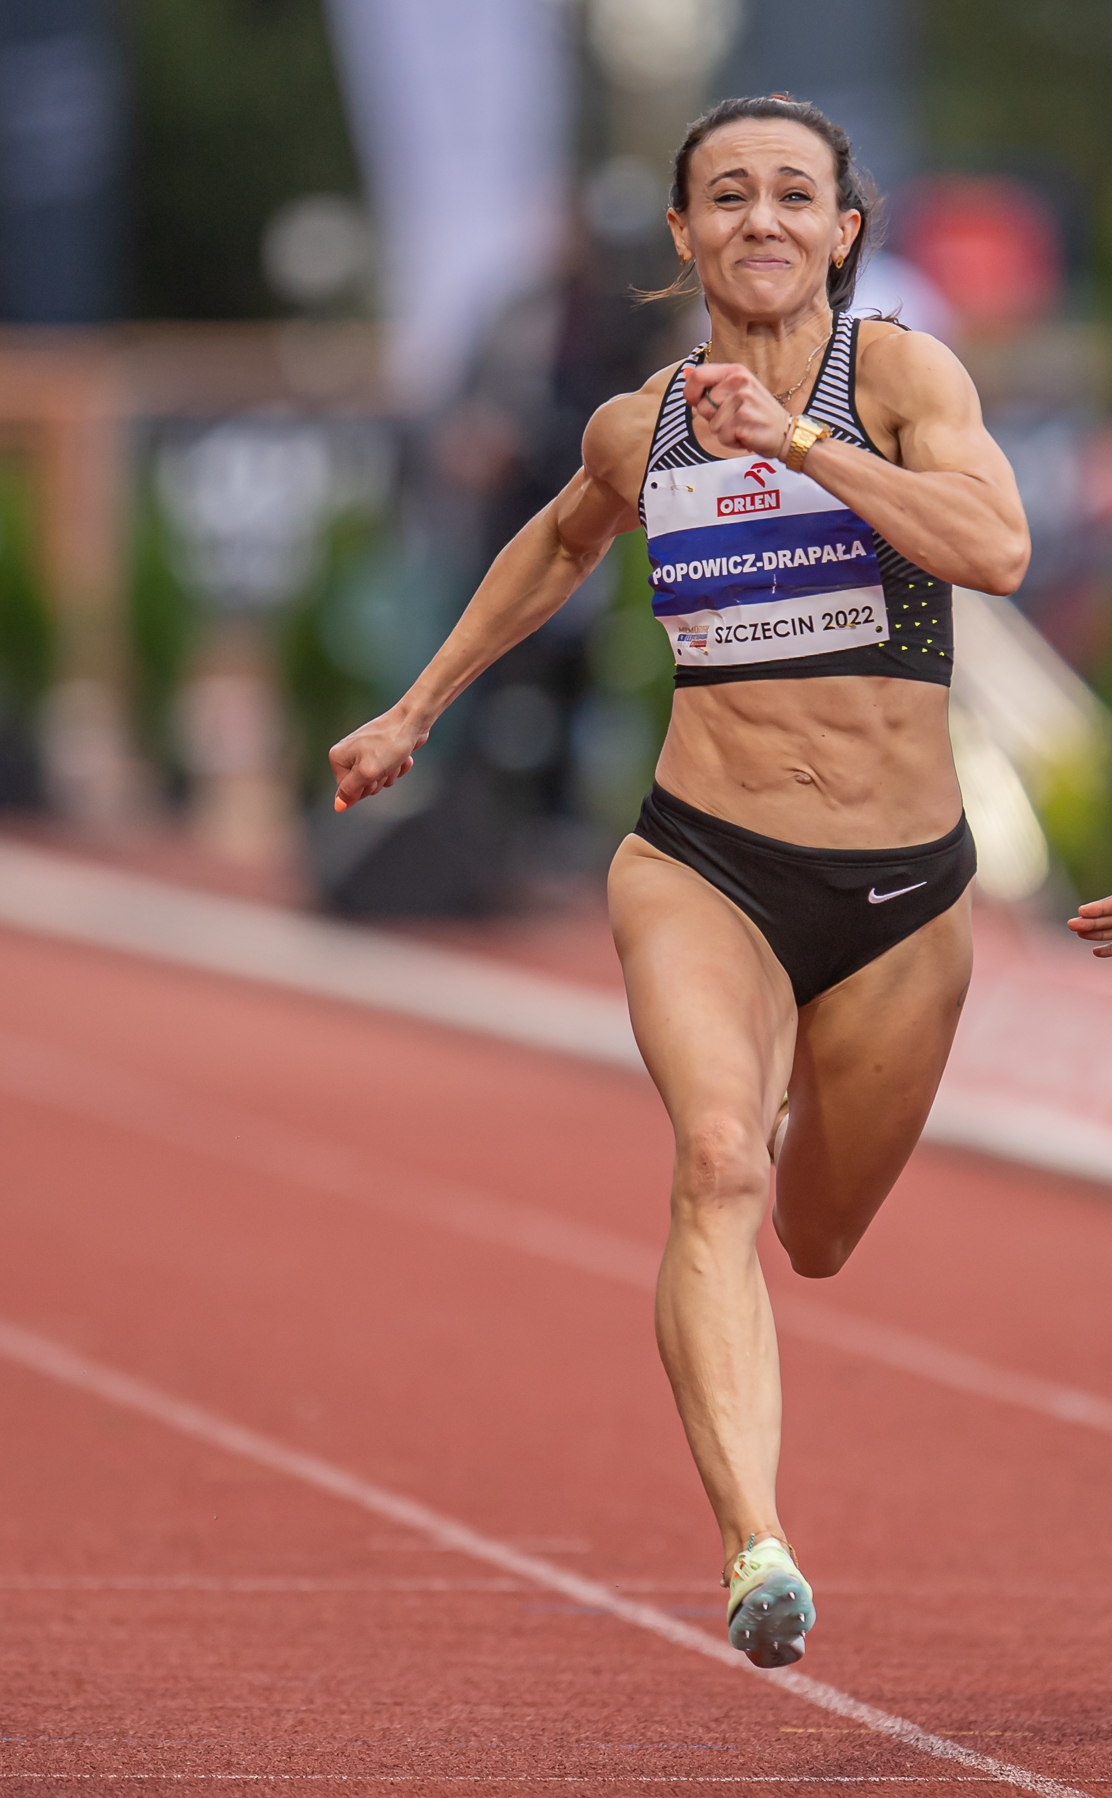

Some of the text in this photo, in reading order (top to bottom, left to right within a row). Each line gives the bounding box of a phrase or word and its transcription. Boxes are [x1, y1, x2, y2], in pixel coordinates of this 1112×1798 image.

[720, 493, 777, 513] ORLEN
[652, 540, 867, 585] POPOWICZ-DRAPAŁA
[714, 606, 875, 644] SZCZECIN 2022
